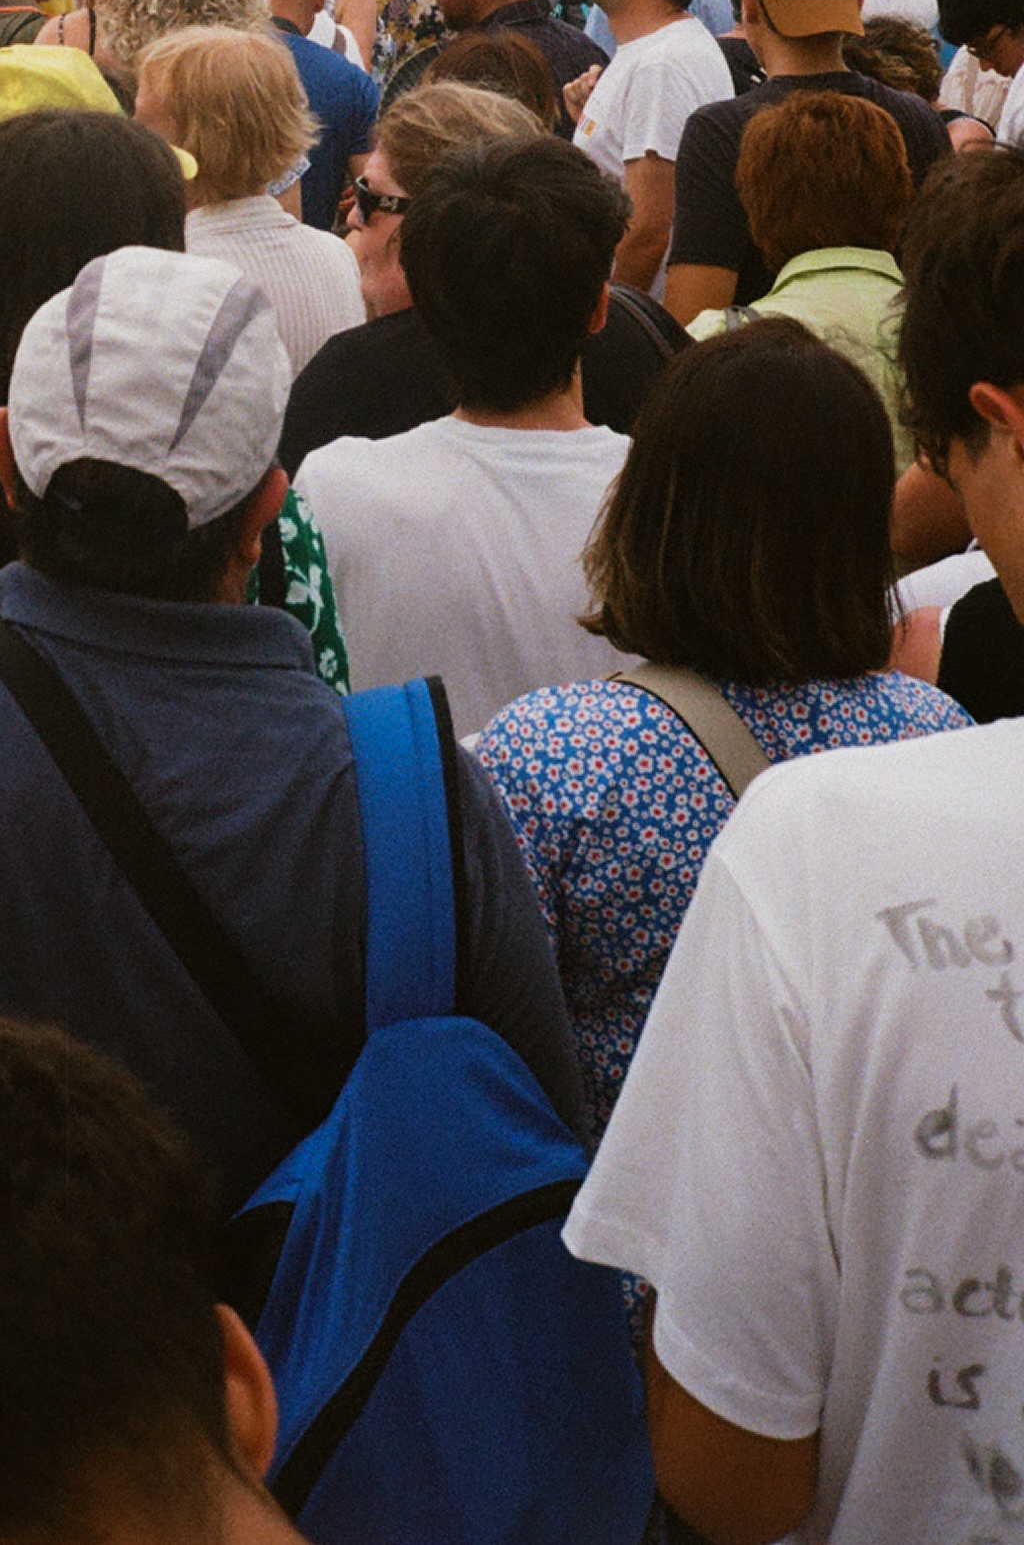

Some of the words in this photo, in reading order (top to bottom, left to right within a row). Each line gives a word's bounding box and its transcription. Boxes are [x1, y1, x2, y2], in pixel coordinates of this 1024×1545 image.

[875, 897, 1014, 971] The
[985, 969, 1024, 1045] t
[900, 1265, 1024, 1321] act
[928, 1356, 987, 1411] is
